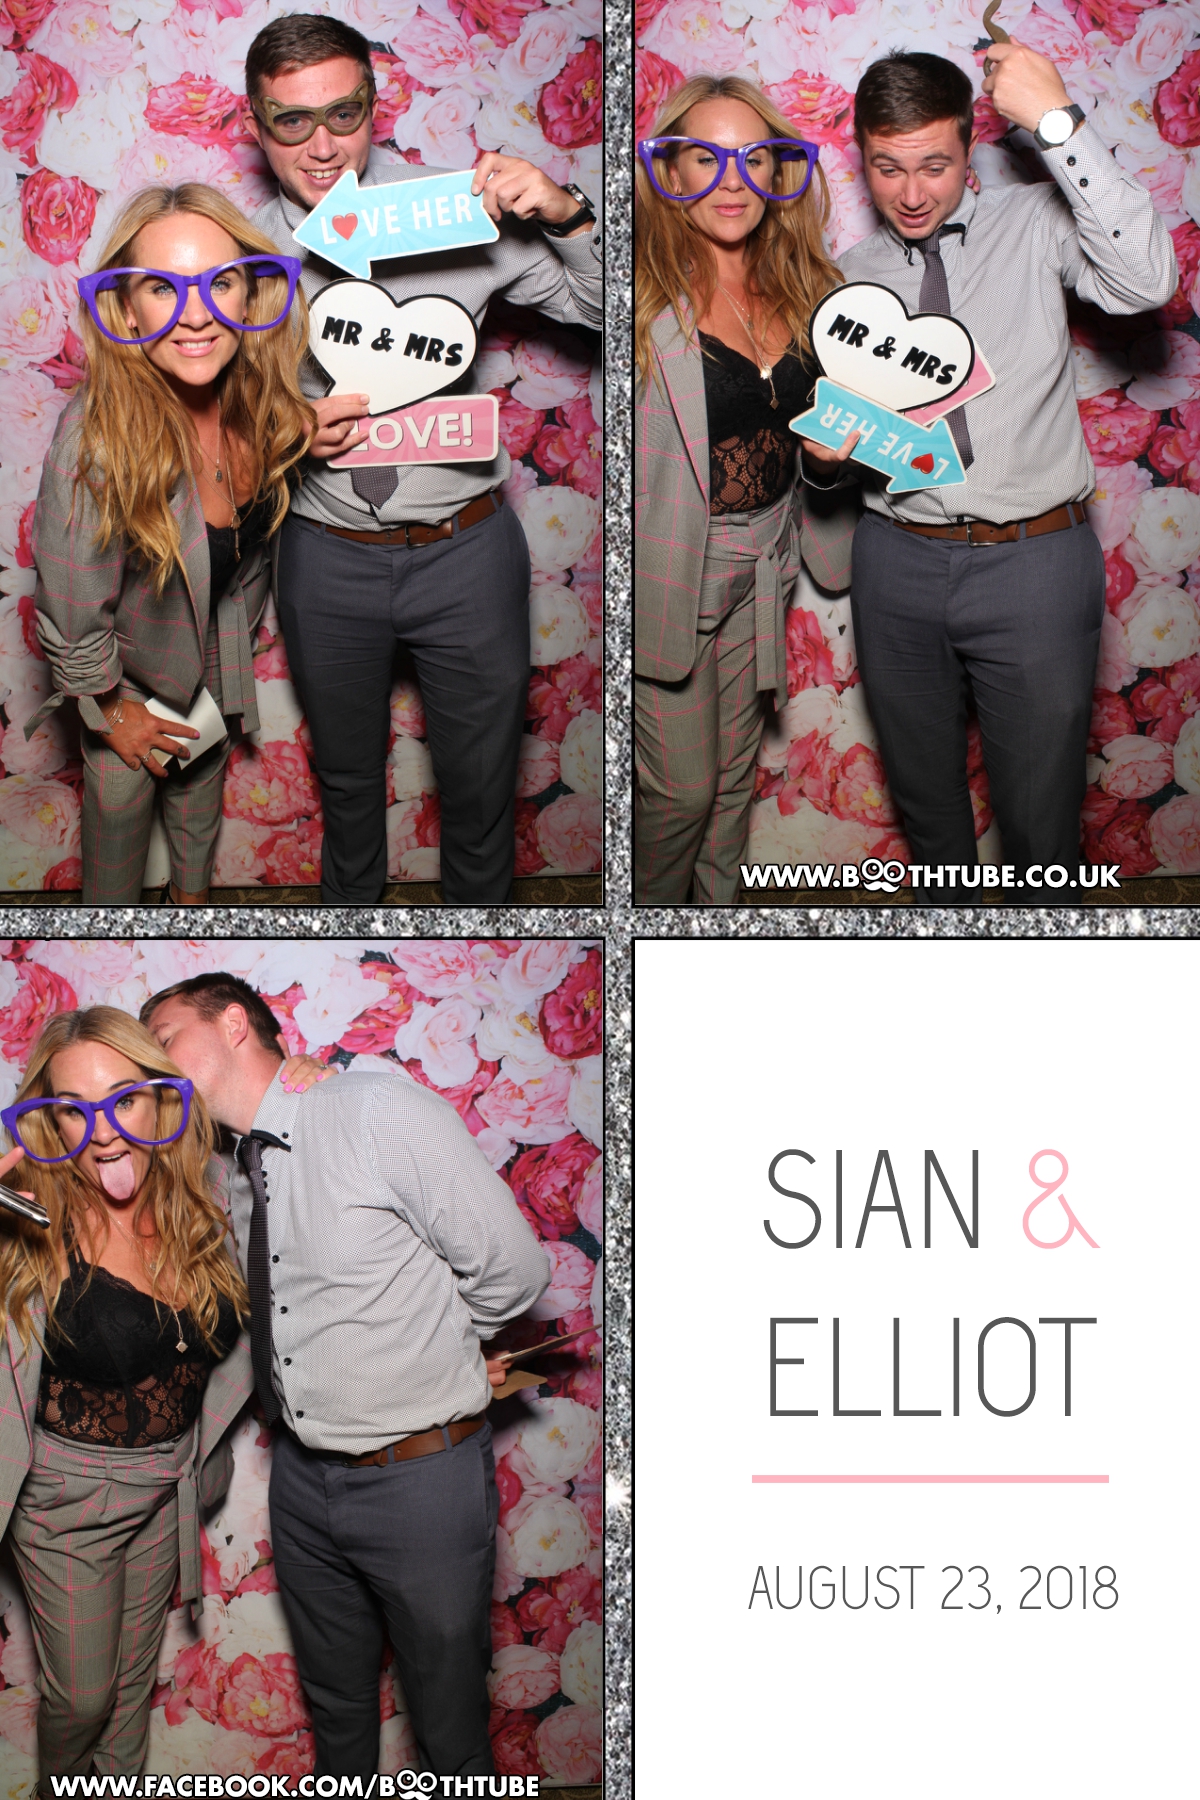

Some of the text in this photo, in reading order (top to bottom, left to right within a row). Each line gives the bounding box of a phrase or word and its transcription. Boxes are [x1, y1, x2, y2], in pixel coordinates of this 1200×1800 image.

[412, 193, 473, 230] HER
[321, 315, 464, 367] MR & MRS
[826, 313, 957, 385] MR & MRS
[819, 402, 878, 446] HER
